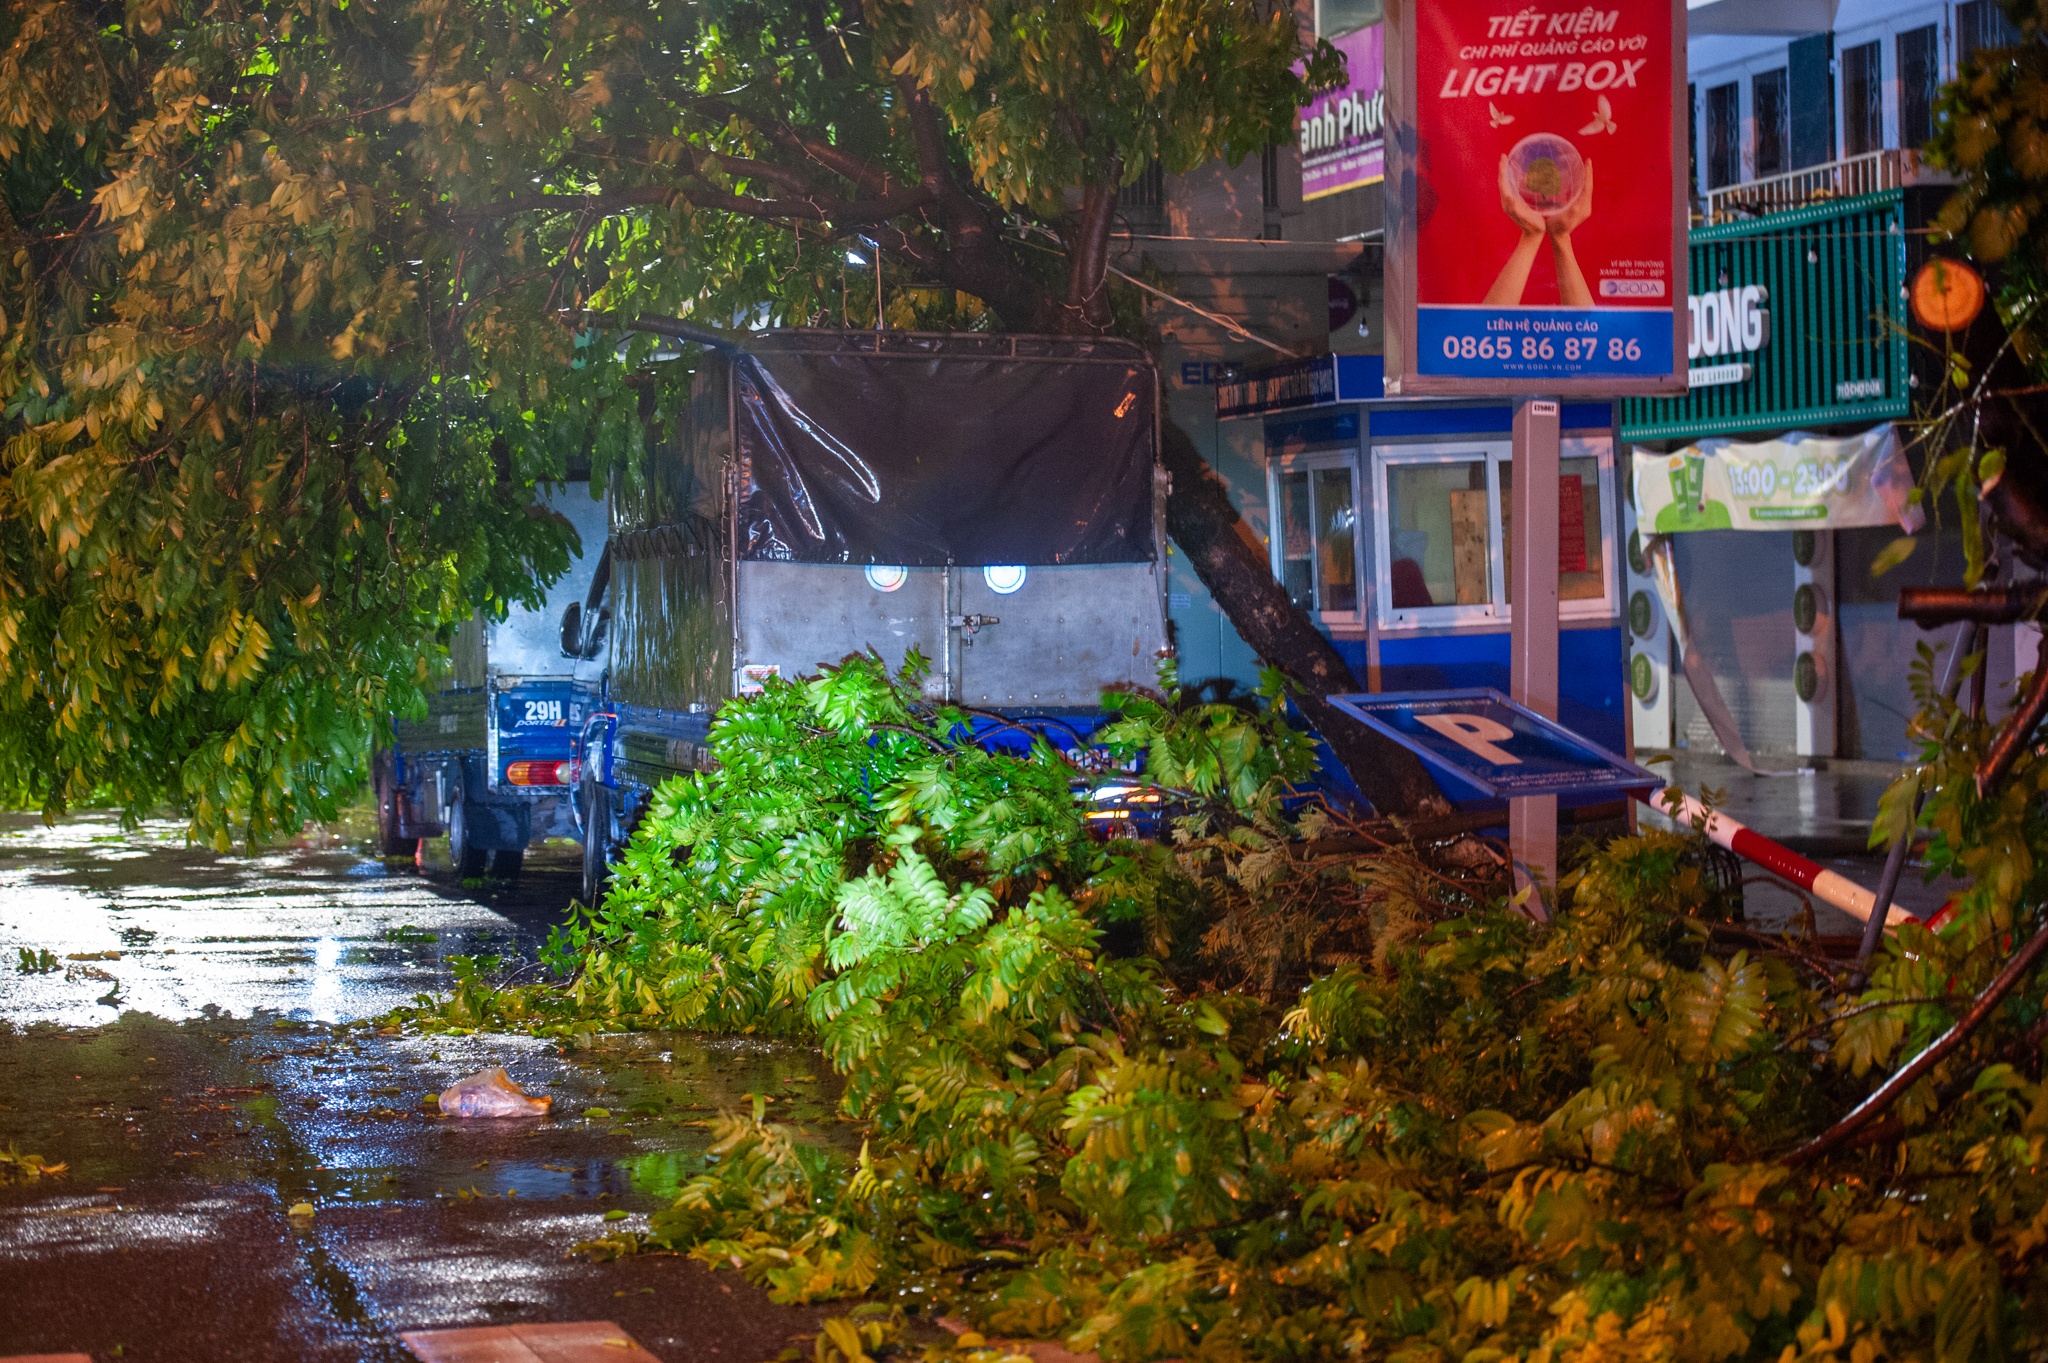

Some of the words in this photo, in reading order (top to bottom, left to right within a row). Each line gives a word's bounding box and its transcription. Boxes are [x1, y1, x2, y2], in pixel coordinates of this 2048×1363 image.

[1486, 5, 1547, 38] TIẾT
[1546, 6, 1619, 40] KIỆM
[1459, 45, 1486, 60] CHI
[1489, 41, 1518, 59] PHÍ
[1519, 38, 1578, 57] QUẢNG
[1580, 36, 1615, 53] CÁO
[1618, 33, 1648, 51] VỚI
[1439, 64, 1557, 98] LIGHT
[1557, 58, 1647, 92] BOX
[1618, 282, 1659, 294] GODA
[1487, 317, 1513, 331] LIÊN
[1515, 318, 1530, 333] HỆ
[1533, 318, 1573, 333] QUẢNG
[1575, 319, 1599, 332] CÁO
[1442, 335, 1513, 360] 0865
[1521, 337, 1555, 360] 86
[1564, 337, 1598, 361] 87
[1607, 337, 1642, 361] 86
[1728, 463, 1776, 496] 13:00
[1793, 461, 1849, 496] 23:00
[525, 700, 562, 720] 29H
[1413, 713, 1523, 765] P
